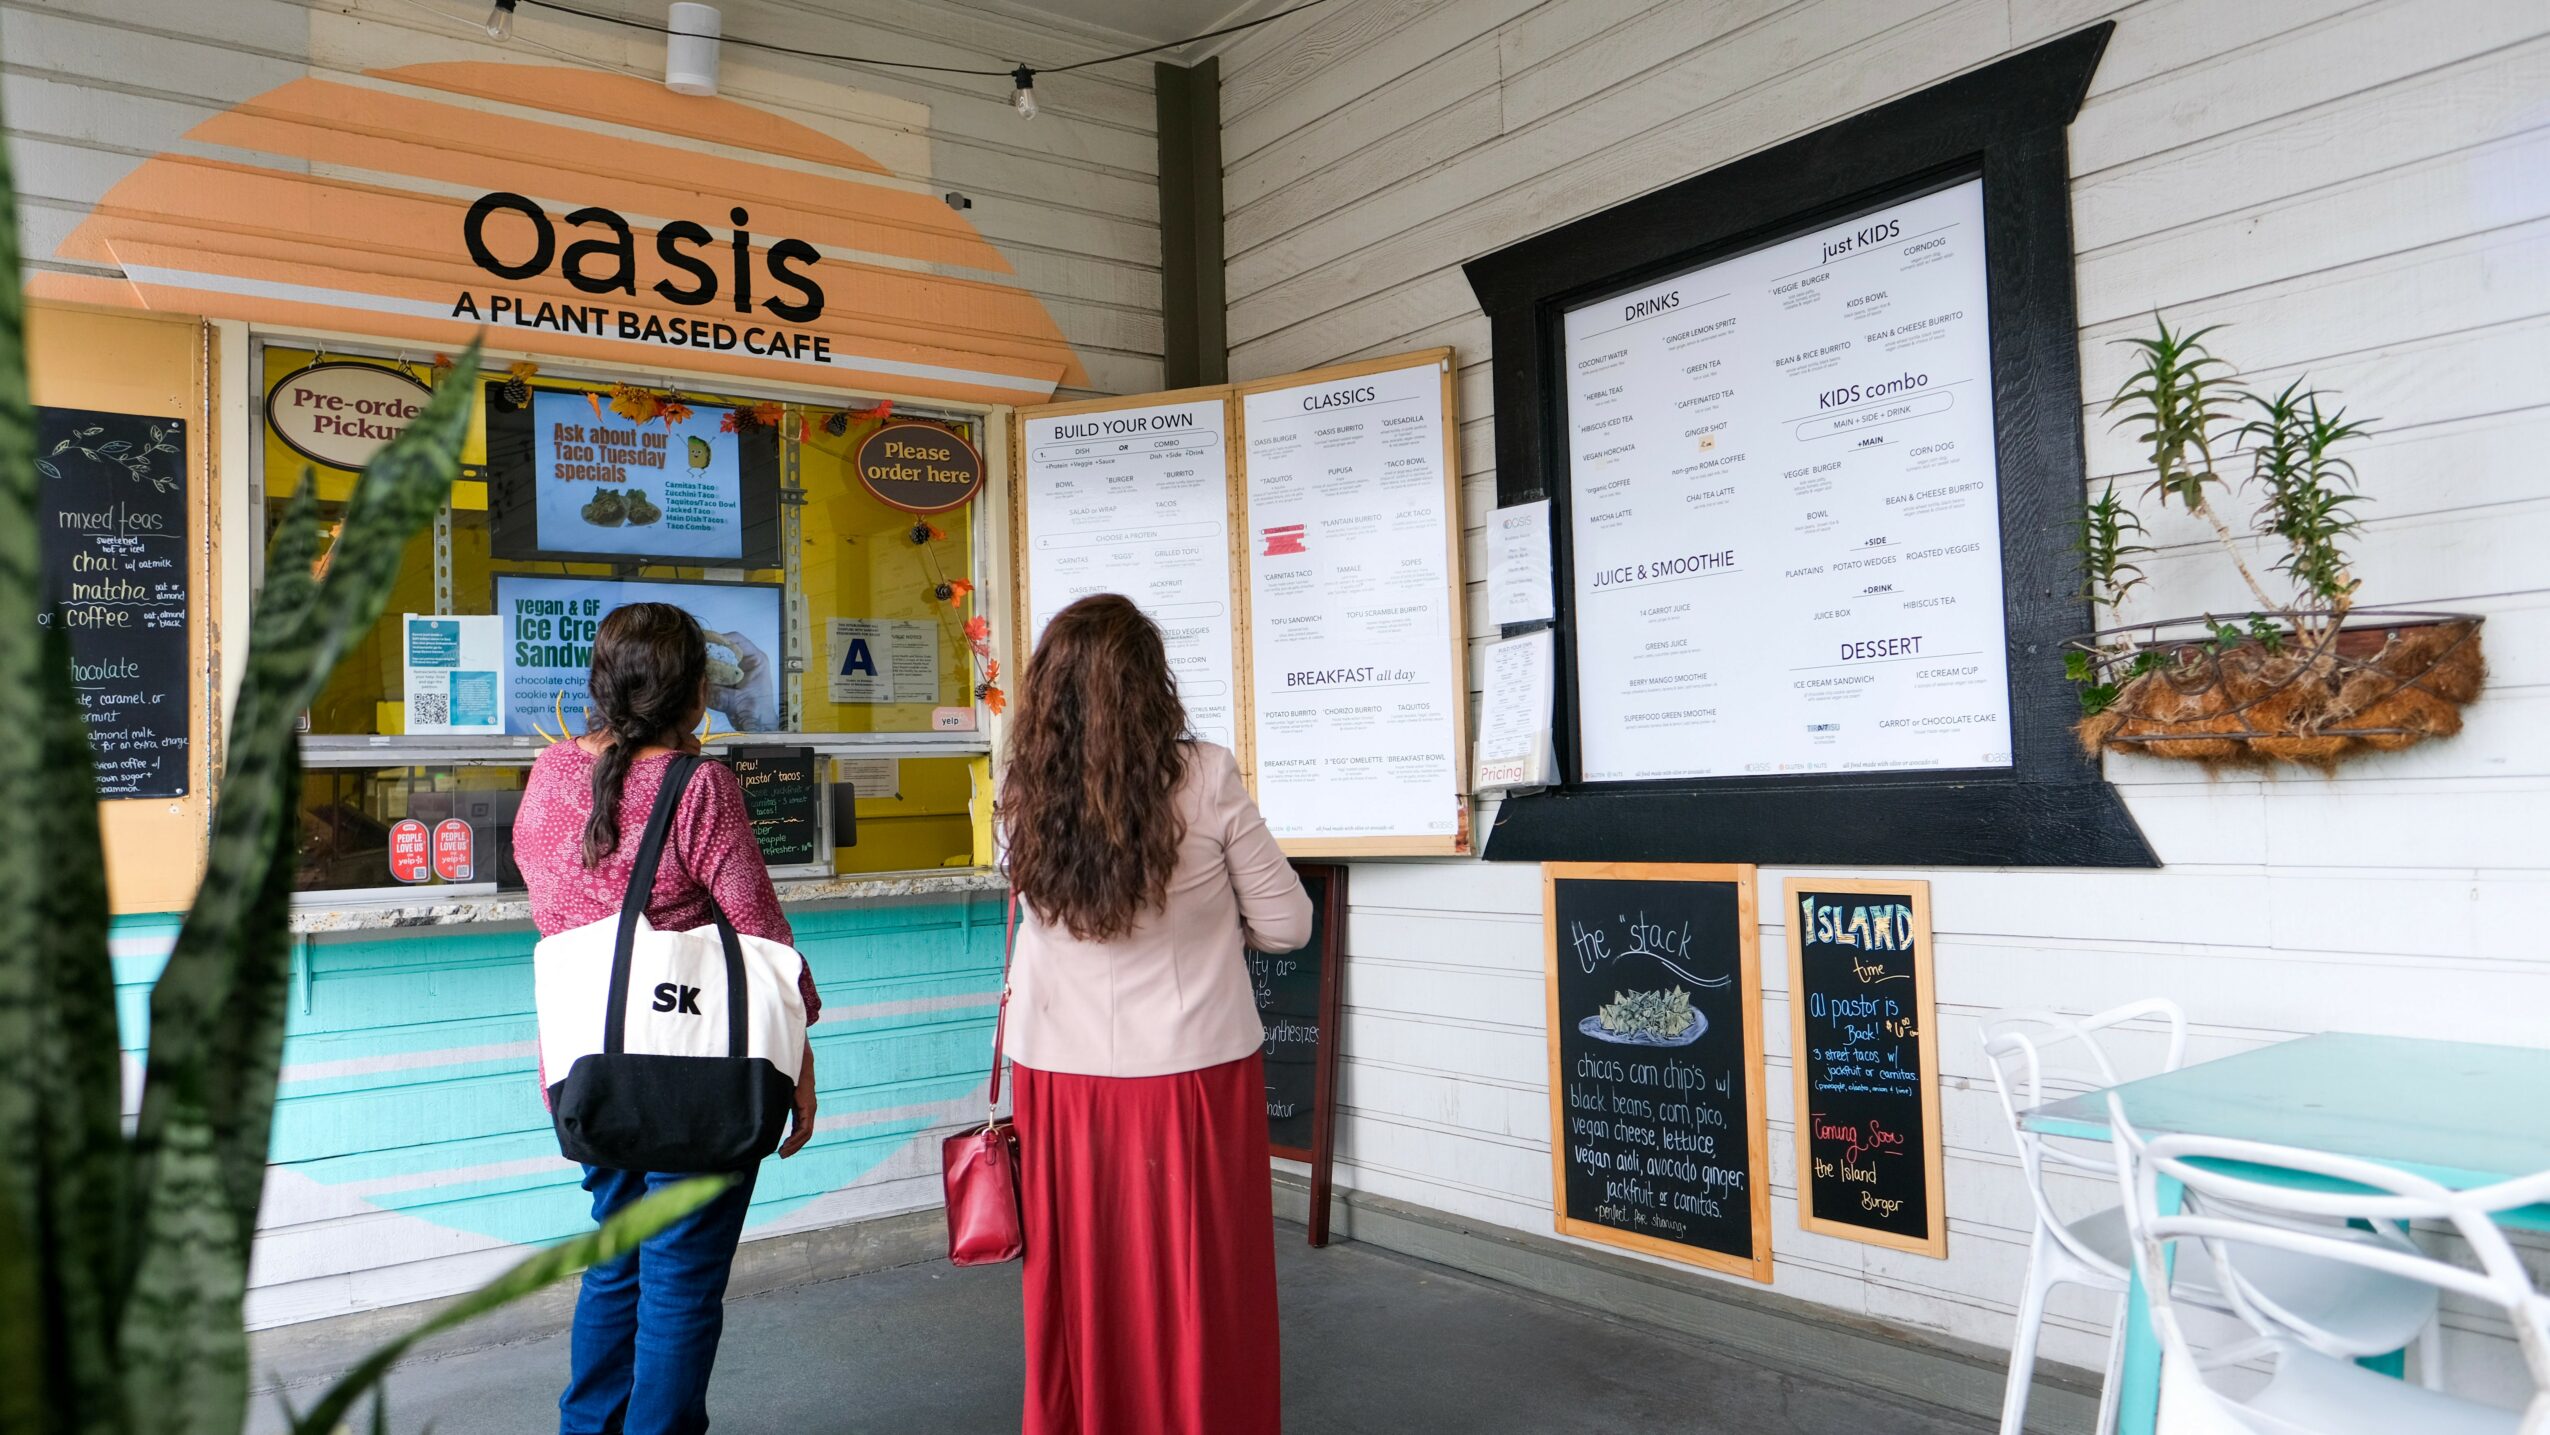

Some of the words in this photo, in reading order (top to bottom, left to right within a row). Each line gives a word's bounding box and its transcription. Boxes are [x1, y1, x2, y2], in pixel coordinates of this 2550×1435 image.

[1822, 237, 1853, 263] just
[1858, 219, 1900, 247] KIDS
[1903, 237, 1946, 256] CORNDOG
[464, 192, 825, 323] oasis
[1773, 282, 1798, 295] VEGGIE
[1801, 273, 1830, 287] BURGER
[1625, 291, 1679, 322] DRINKS
[452, 292, 480, 320] A
[490, 295, 609, 336] PLANT
[618, 311, 737, 350] BASED
[744, 327, 832, 363] CAFE
[1666, 331, 1690, 344] GINGER
[1691, 326, 1714, 337] LEMON
[1716, 318, 1736, 329] SPRITZ
[1579, 355, 1607, 369] COCONUT
[1608, 350, 1628, 360] WATER
[1303, 387, 1375, 411] CLASSICS
[1820, 385, 1860, 409] KIDS
[1866, 372, 1928, 398] combo
[1055, 423, 1099, 439] BUILD
[1103, 418, 1146, 434] YOUR
[1152, 413, 1193, 429] OWN
[1318, 428, 1336, 436] OASIS
[1337, 424, 1363, 434] BURRITO
[1384, 415, 1424, 426] QUESADILLA
[554, 423, 585, 442] Ask
[590, 427, 637, 447] about
[642, 432, 668, 449] our
[1858, 436, 1883, 447] +MAIN
[555, 442, 594, 463] Taco
[599, 446, 666, 469] Tuesday
[885, 442, 950, 461] Please
[1583, 451, 1602, 462] VEGAN
[1603, 444, 1635, 456] HORCHATA
[1910, 446, 1933, 457] CORN
[1935, 442, 1955, 453] DOG
[555, 463, 626, 482] specials
[1328, 467, 1353, 475] PUPUSA
[1387, 460, 1405, 468] TACO
[1406, 457, 1426, 465] BOWL
[868, 464, 921, 481] order
[928, 465, 971, 484] here
[1166, 470, 1194, 478] BURRITO
[665, 481, 696, 490] Carnitas
[698, 483, 715, 491] Taco
[665, 490, 696, 498] Zucchini
[666, 506, 692, 514] Jacked
[693, 507, 711, 515] Taco
[719, 500, 736, 508] Bowl
[59, 505, 114, 529] mixed
[118, 501, 163, 539] teas
[666, 514, 684, 522] Main
[1865, 537, 1887, 546] +SIDE
[73, 551, 118, 572] chai
[125, 560, 135, 571] w/
[1833, 561, 1862, 571] POTATO
[1864, 556, 1897, 567] WEDGES
[1907, 548, 1943, 560] ROASTED
[1945, 543, 1980, 555] VEGGIES
[1594, 566, 1633, 587] JUICE
[1637, 565, 1647, 579] &
[1652, 550, 1734, 578] SMOOTHIE
[72, 577, 150, 600] matcha
[67, 606, 132, 629] coffee
[569, 600, 578, 615] &
[583, 599, 600, 616] GF
[515, 615, 550, 640] Ice
[559, 616, 599, 641] Cre
[1272, 617, 1288, 625] TOFU
[1289, 615, 1322, 624] SANDWICH
[515, 641, 593, 668] Sandw
[840, 639, 878, 676] A
[1841, 636, 1923, 661] DESSERT
[71, 657, 140, 681] hocolate
[1288, 667, 1374, 687] BREAKFAST
[1376, 670, 1391, 682] all
[1394, 669, 1416, 682] day
[515, 676, 563, 685] chocolate
[565, 676, 586, 687] chip
[1794, 680, 1805, 688] ICE
[1807, 678, 1832, 687] CREAM
[1834, 675, 1875, 685] SANDWICH
[515, 690, 547, 699] cookie
[941, 716, 958, 725] yelp
[1624, 713, 1660, 722] SUPERFOOD
[1662, 711, 1682, 719] GREEN
[1683, 709, 1716, 717] SMOOTHIE
[1879, 719, 1910, 728] CARROT
[1922, 715, 1972, 726] CHOCOLATE
[1974, 714, 1996, 722] CAKE
[88, 729, 128, 740] almond
[132, 727, 155, 738] milk
[736, 759, 758, 771] new!
[1481, 766, 1522, 782] Pricing
[746, 772, 771, 788] pastor
[397, 833, 422, 842] PEOPLE
[397, 843, 413, 853] LOVE
[414, 843, 423, 852] US
[398, 858, 414, 866] yelp
[1802, 896, 1914, 950] ISLAND
[1571, 920, 1611, 974] the
[1853, 957, 1884, 983] time
[652, 982, 702, 1015] SK
[1832, 994, 1880, 1028] pastor
[1886, 997, 1898, 1016] is
[1843, 1022, 1880, 1045] Back!
[1813, 1049, 1821, 1060] 3
[1825, 1047, 1849, 1061] street
[1855, 1048, 1880, 1062] tacos
[1887, 1046, 1898, 1068] w/
[1578, 1052, 1624, 1082] chicas
[1716, 1070, 1730, 1099] w/
[1866, 1069, 1875, 1077] or
[1571, 1084, 1607, 1112] black
[1613, 1087, 1655, 1123] beans,
[1696, 1103, 1727, 1133] pico,
[1572, 1117, 1609, 1146] vegan
[1614, 1119, 1659, 1151] cheese,
[1663, 1127, 1717, 1159] lettuce,
[1815, 1118, 1868, 1163] Coming
[1869, 1120, 1903, 1147] Soon
[1575, 1145, 1611, 1176] vegan
[1647, 1154, 1696, 1182] avocado
[1814, 1157, 1834, 1178] the
[1841, 1159, 1876, 1184] Island
[1604, 1176, 1654, 1208] jackfruit
[1660, 1192, 1668, 1202] or
[1674, 1192, 1722, 1218] carnitas.
[1862, 1191, 1903, 1217] Burger
